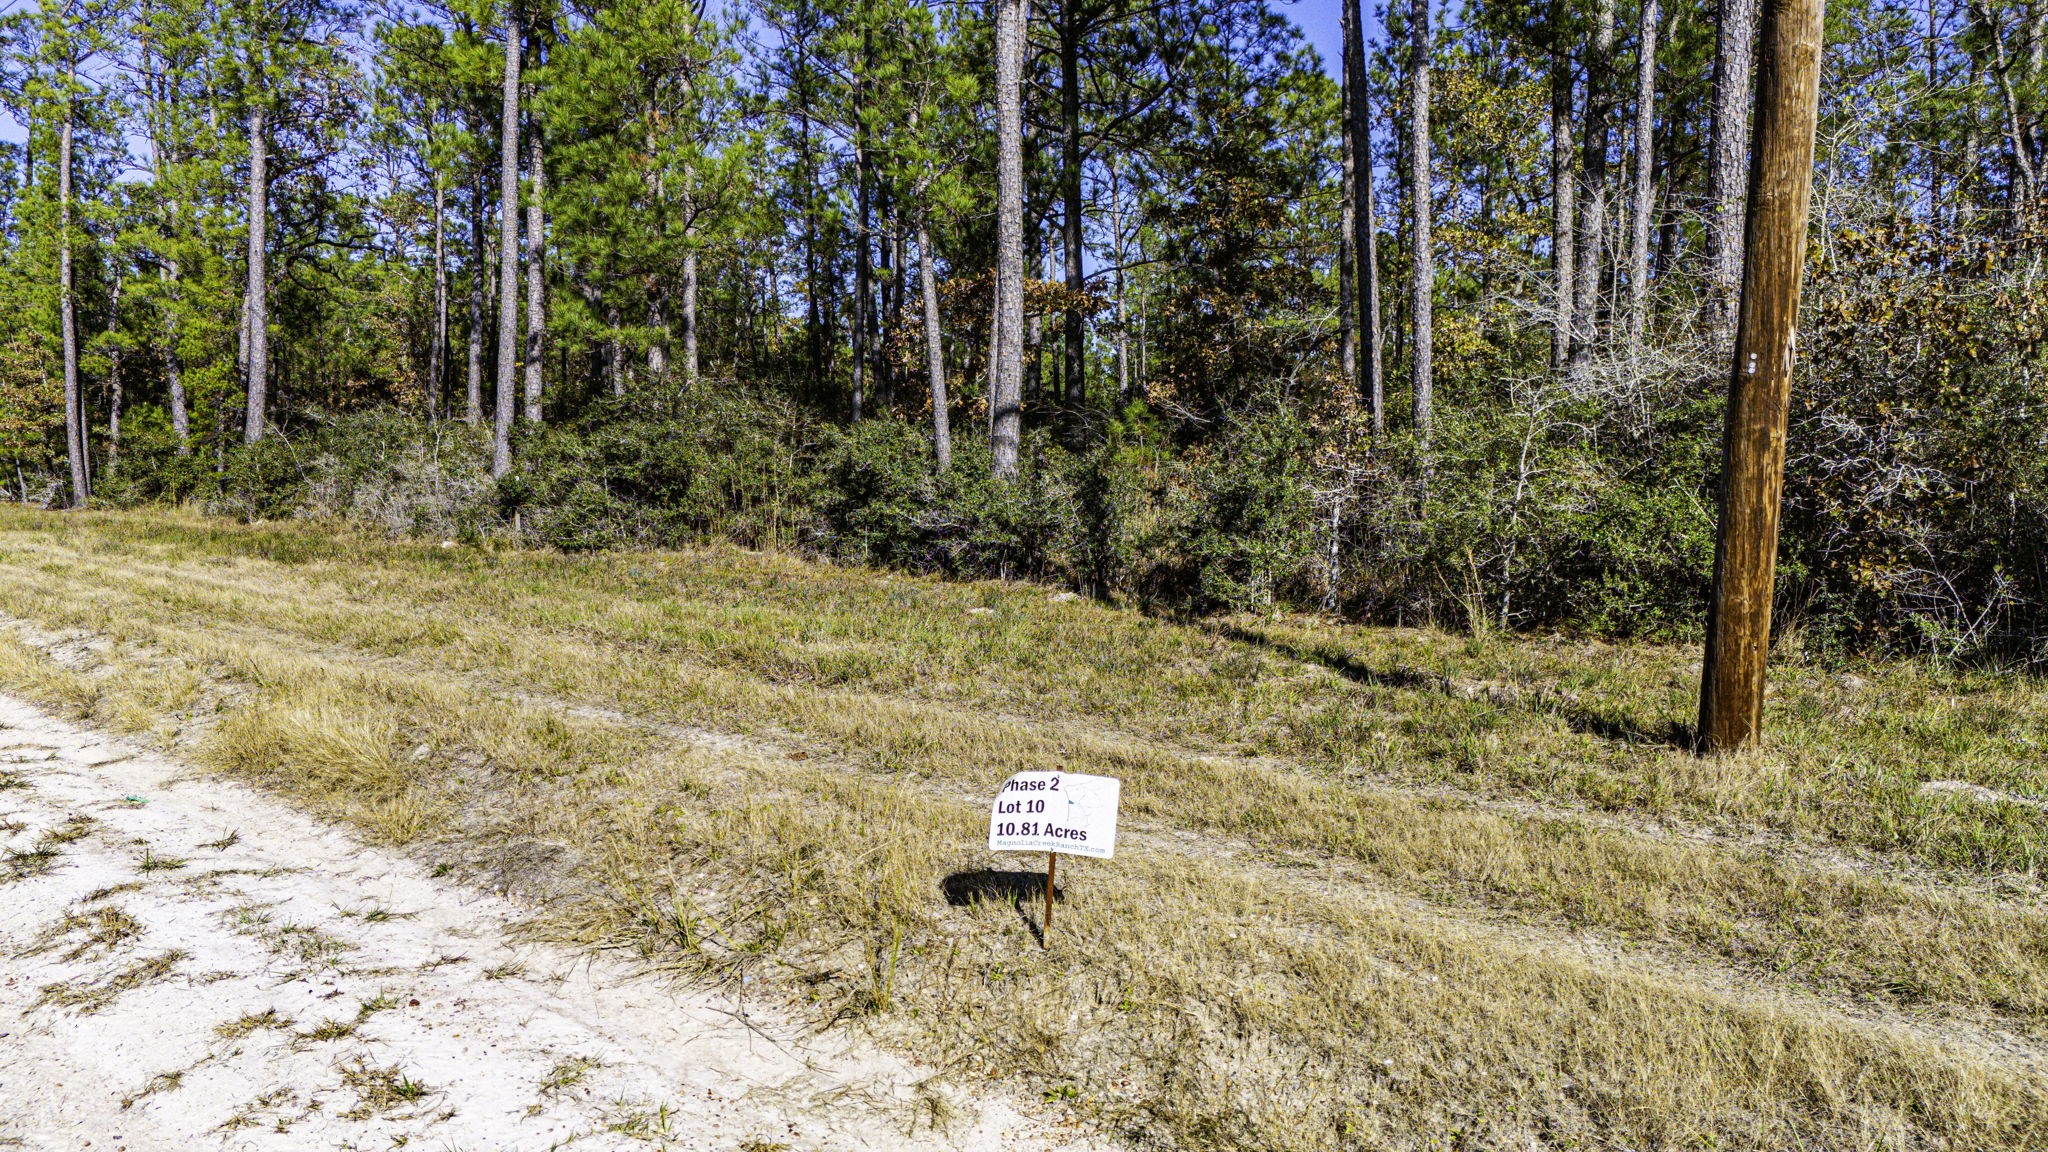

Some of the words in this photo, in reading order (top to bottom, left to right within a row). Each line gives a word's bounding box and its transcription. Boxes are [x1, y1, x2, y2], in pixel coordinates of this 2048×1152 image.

[1049, 777, 1060, 792] 2
[998, 800, 1022, 814] Lot
[1026, 799, 1045, 814] 10
[996, 822, 1040, 837] 10.81
[1043, 822, 1087, 841] Acres
[996, 840, 1106, 854] MagnoliaCreekRanchTX.com
